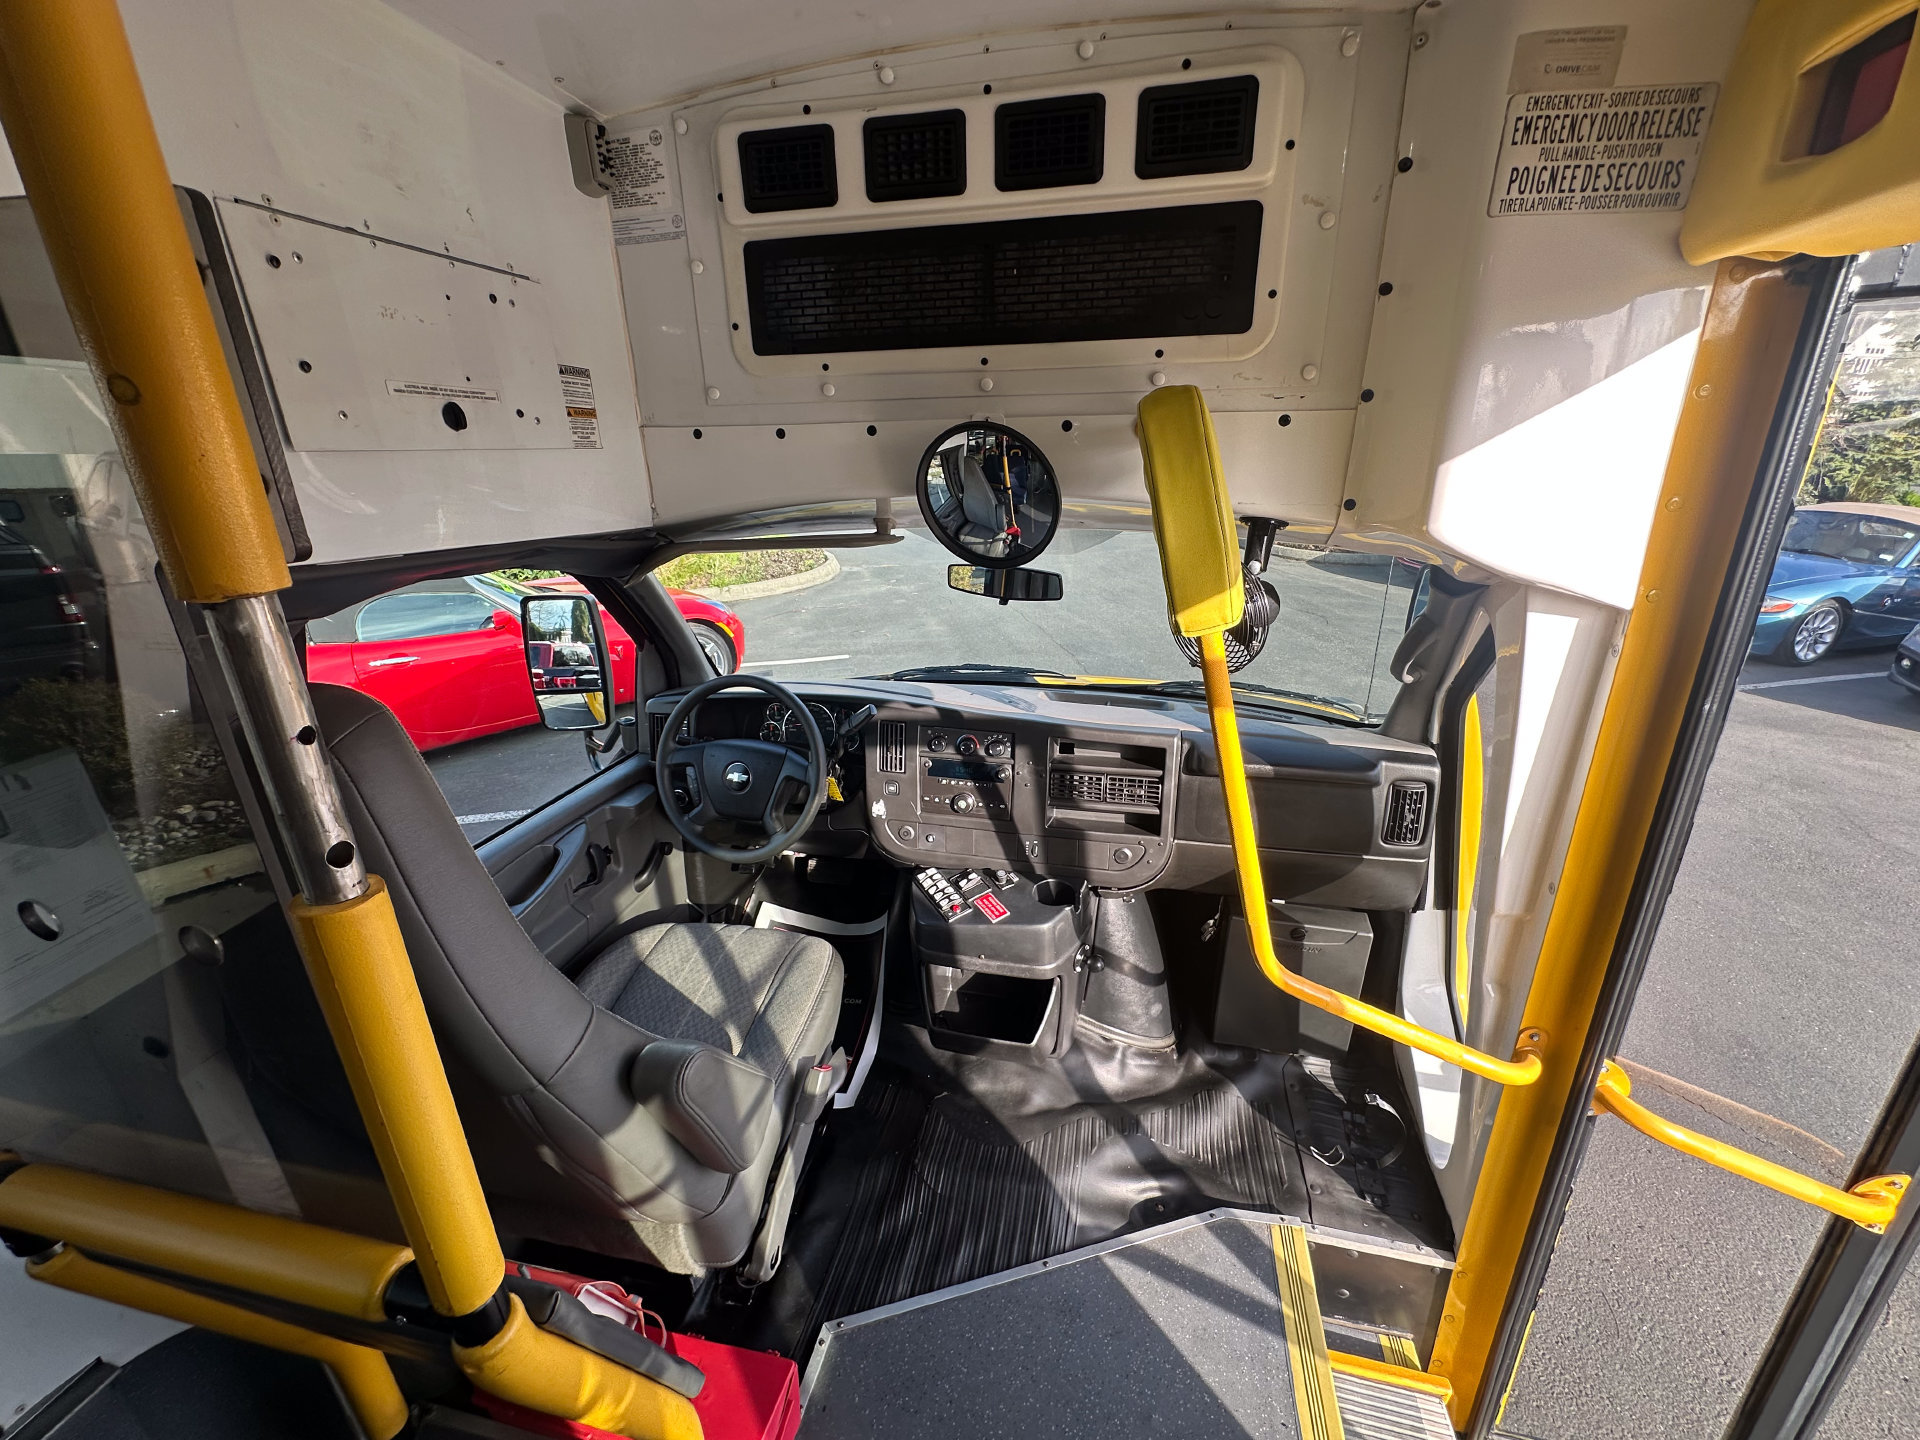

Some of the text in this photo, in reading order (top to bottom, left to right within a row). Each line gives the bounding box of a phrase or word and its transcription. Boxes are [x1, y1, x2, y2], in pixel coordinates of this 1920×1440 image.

[1526, 94, 1583, 112] EMERGENCY
[1582, 93, 1605, 109] EXIT
[1608, 91, 1643, 108] SORTIE
[1642, 89, 1658, 106] DE
[1656, 86, 1702, 105] SECOURS
[1511, 106, 1706, 145] EMERGENCY DOOR RELEASE
[1539, 146, 1561, 162] PULL
[1560, 145, 1598, 161] HANDLE
[1601, 143, 1627, 160] PUSH
[1626, 143, 1638, 159] TO
[1636, 142, 1664, 158] OPEN
[1507, 160, 1685, 195] POIGNEE DE SECOURS
[1498, 197, 1525, 214] TIRER
[1523, 197, 1536, 212] LA
[1535, 195, 1576, 212] POIGNEE
[1578, 194, 1621, 211] POUSSER
[1619, 193, 1647, 209] POUR
[1645, 191, 1682, 208] OUVRIR
[563, 367, 590, 378] WARNING
[573, 408, 597, 418] WARNING
